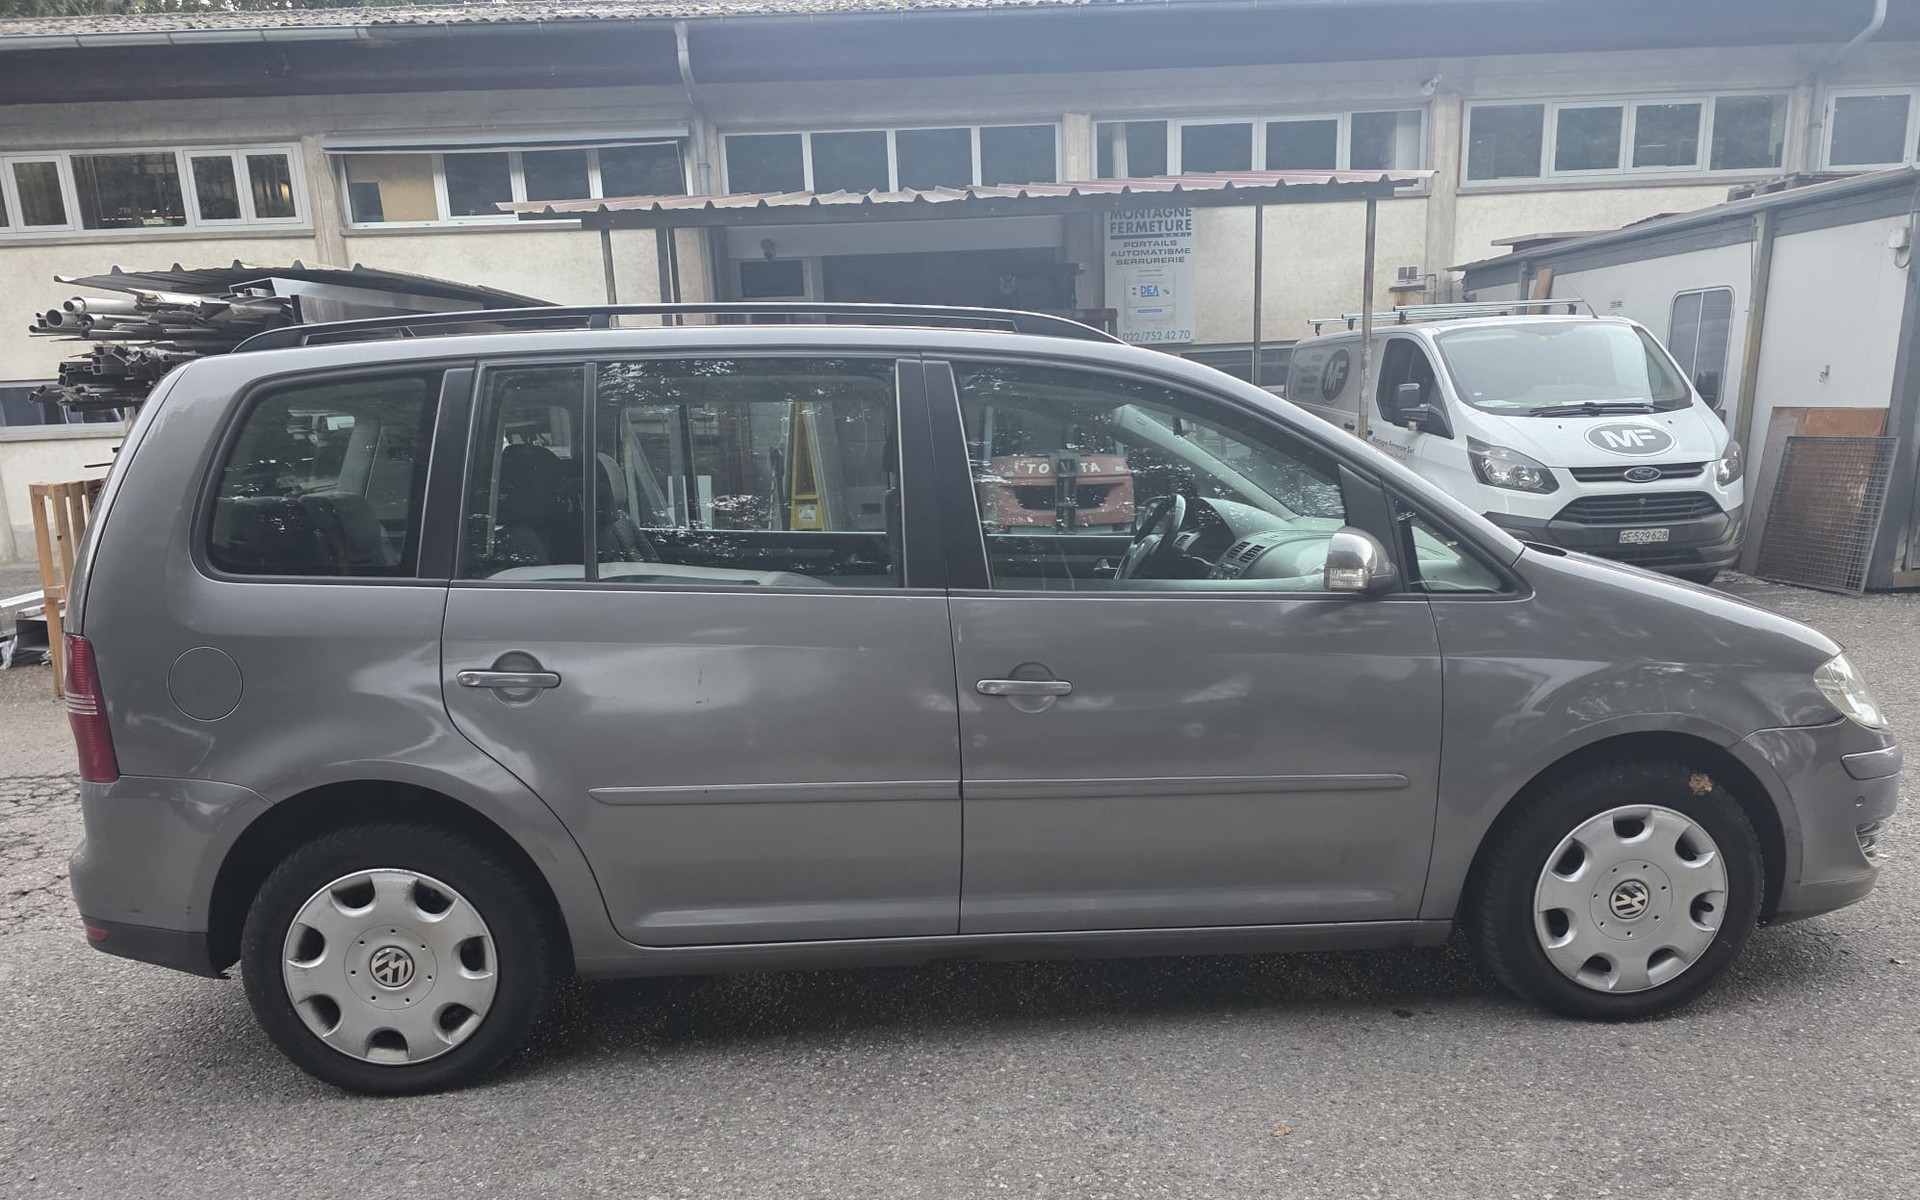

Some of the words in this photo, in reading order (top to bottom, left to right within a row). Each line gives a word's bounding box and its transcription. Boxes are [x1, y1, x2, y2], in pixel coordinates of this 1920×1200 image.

[1110, 208, 1191, 220] MONTAGNE
[1110, 219, 1191, 234] FERMETURE
[1124, 240, 1177, 248] PORTAILS
[1110, 248, 1191, 257] AUTOMATISME
[1116, 257, 1185, 265] SERRURERIE
[1140, 285, 1159, 297] DEA
[1123, 331, 1162, 342] 022/752
[1165, 330, 1176, 340] 42
[1179, 329, 1191, 340] 70
[1324, 360, 1347, 390] MF
[1600, 428, 1657, 448] MF
[1027, 462, 1101, 474] TOTA
